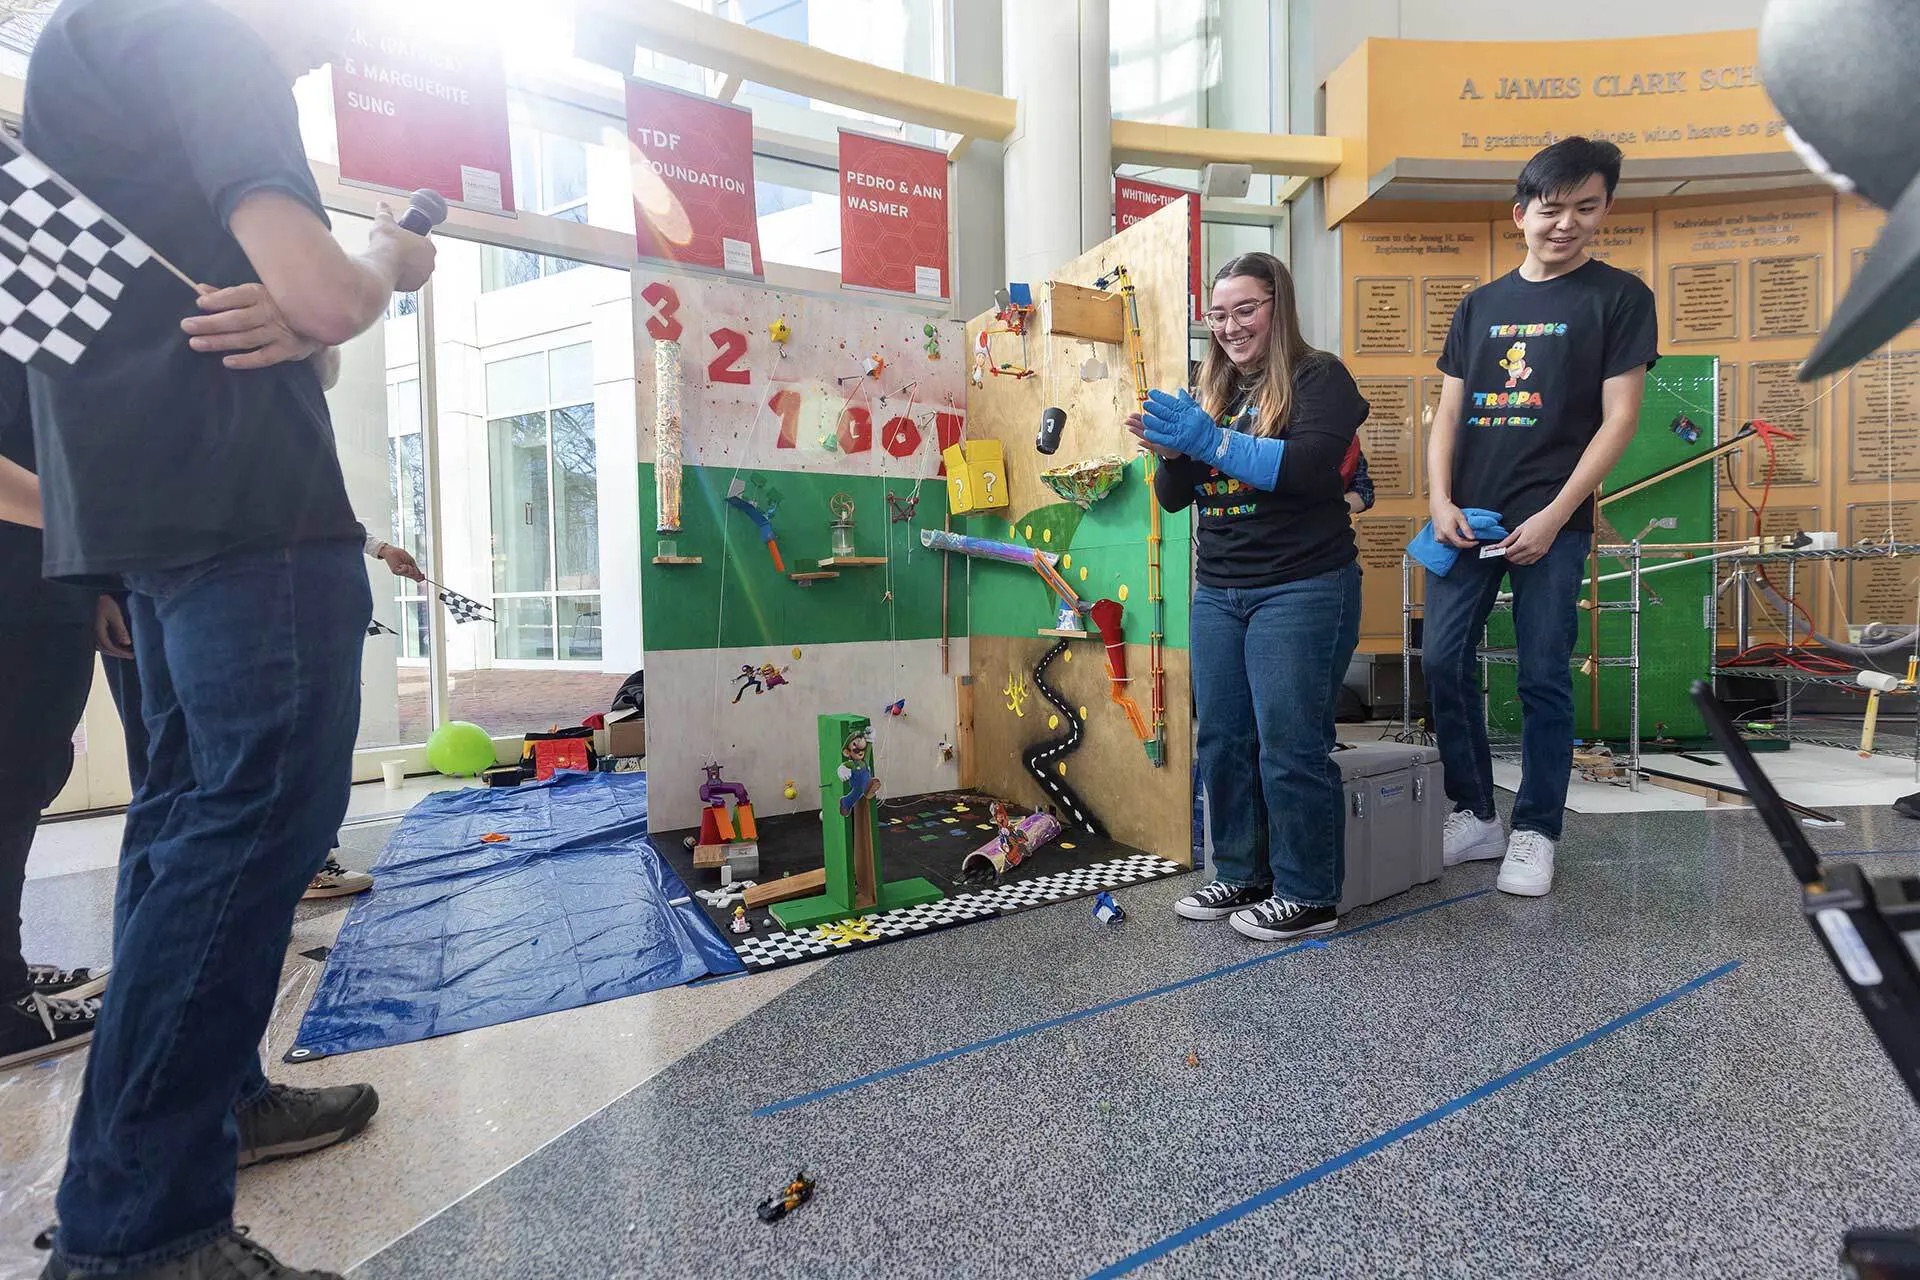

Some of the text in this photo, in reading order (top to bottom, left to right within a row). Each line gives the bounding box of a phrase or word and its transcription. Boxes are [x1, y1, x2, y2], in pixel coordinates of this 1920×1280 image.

[345, 57, 471, 106] & MARGUERITE
[1494, 77, 1581, 100] JAMES
[1592, 73, 1687, 98] CLARK
[1700, 65, 1760, 91] SCH
[346, 91, 396, 117] SUNG
[637, 127, 680, 151] TDF
[1461, 132, 1479, 148] In
[1644, 126, 1681, 142] who
[1687, 123, 1732, 140] have
[1737, 123, 1760, 136] so
[846, 170, 943, 201] PEDRO & ANN
[846, 195, 909, 218] WASMER
[1604, 235, 1632, 247] School
[1613, 224, 1645, 236] Society
[1375, 245, 1425, 256] Engineering
[641, 281, 683, 342] 3
[1489, 322, 1568, 338] TESTUDO'S
[708, 327, 751, 385] 2
[1472, 391, 1543, 409] TROOPA
[1467, 416, 1538, 427] MSE PIT CREW
[1226, 503, 1257, 516] CREW
